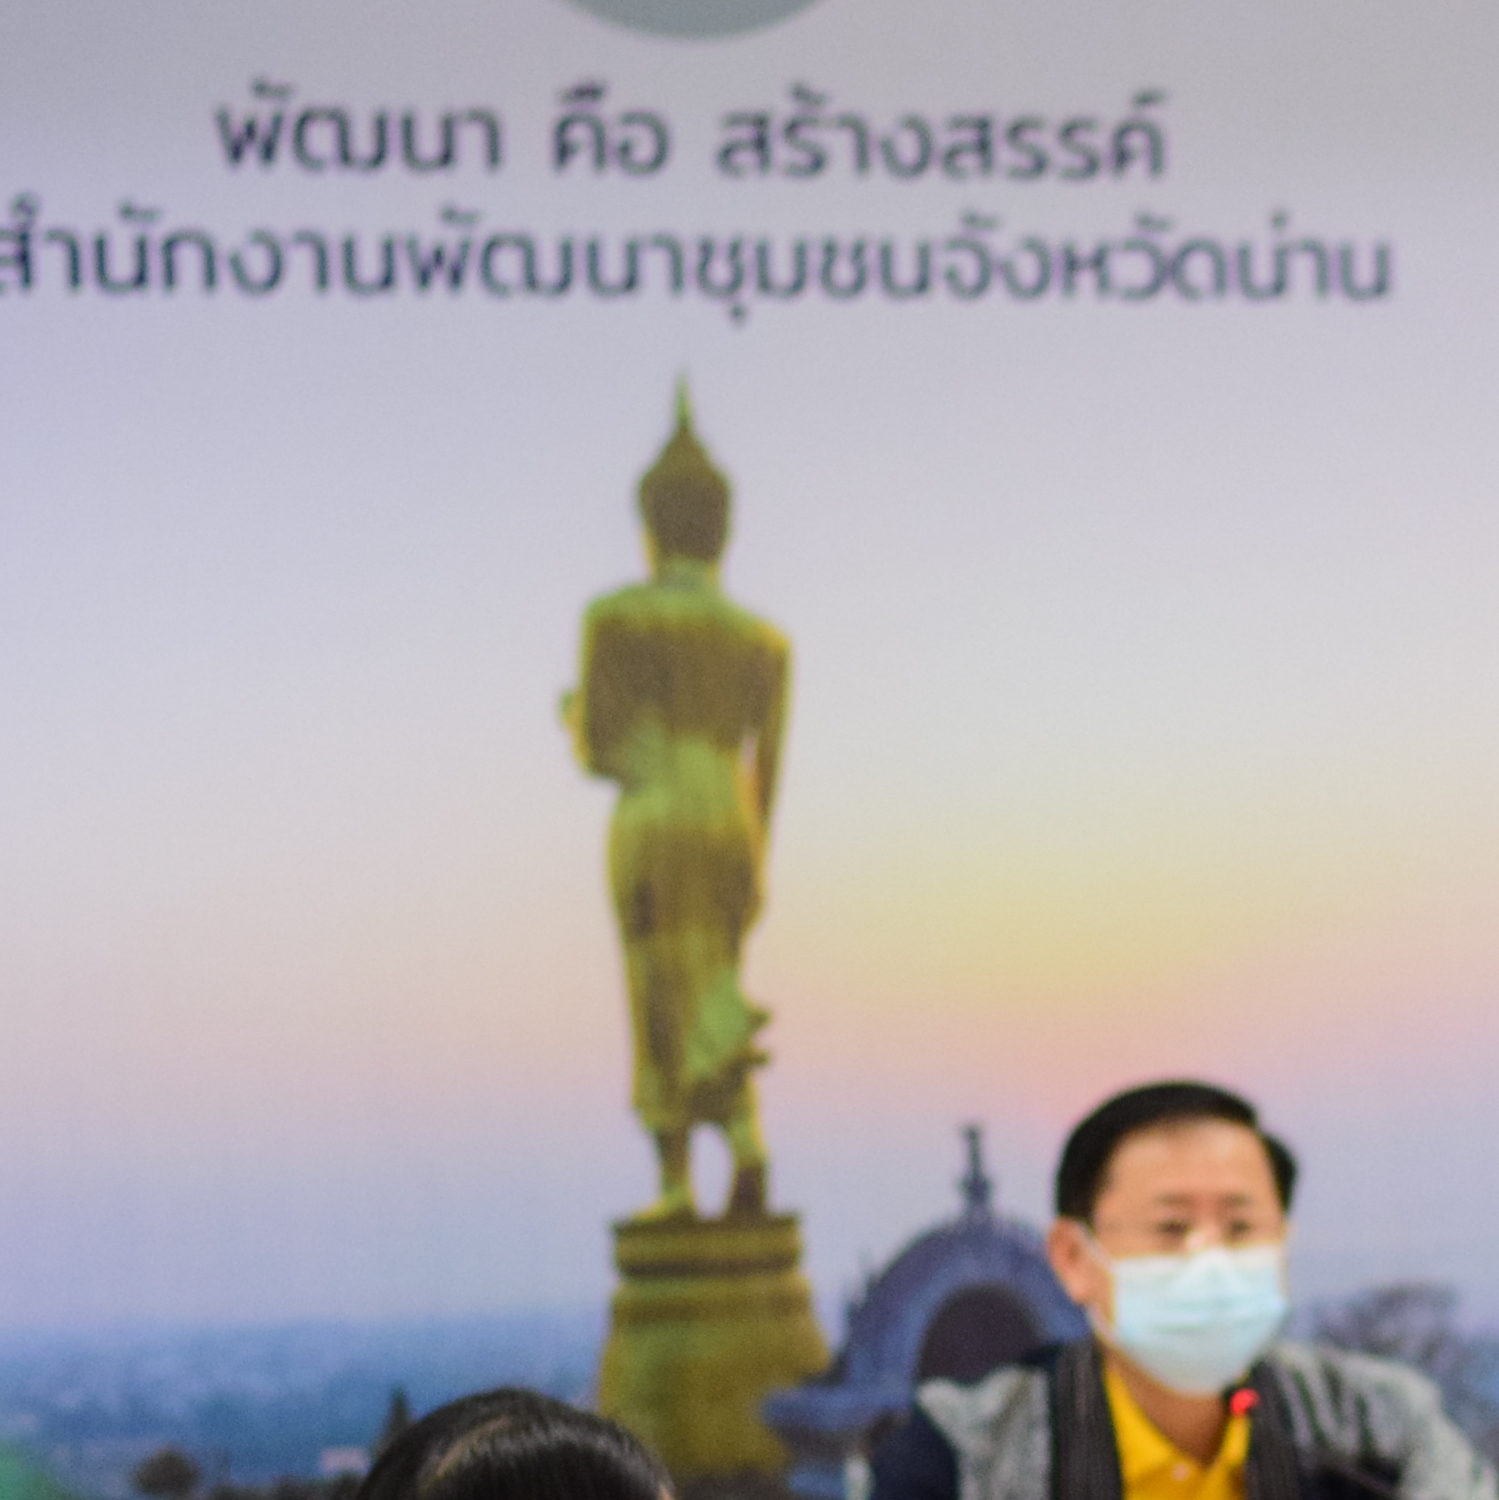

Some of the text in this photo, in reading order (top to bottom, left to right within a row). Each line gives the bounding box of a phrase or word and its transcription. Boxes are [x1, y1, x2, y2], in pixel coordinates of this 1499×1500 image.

[214, 78, 1168, 180] พัฒนา คือ สร้างสรรค์
